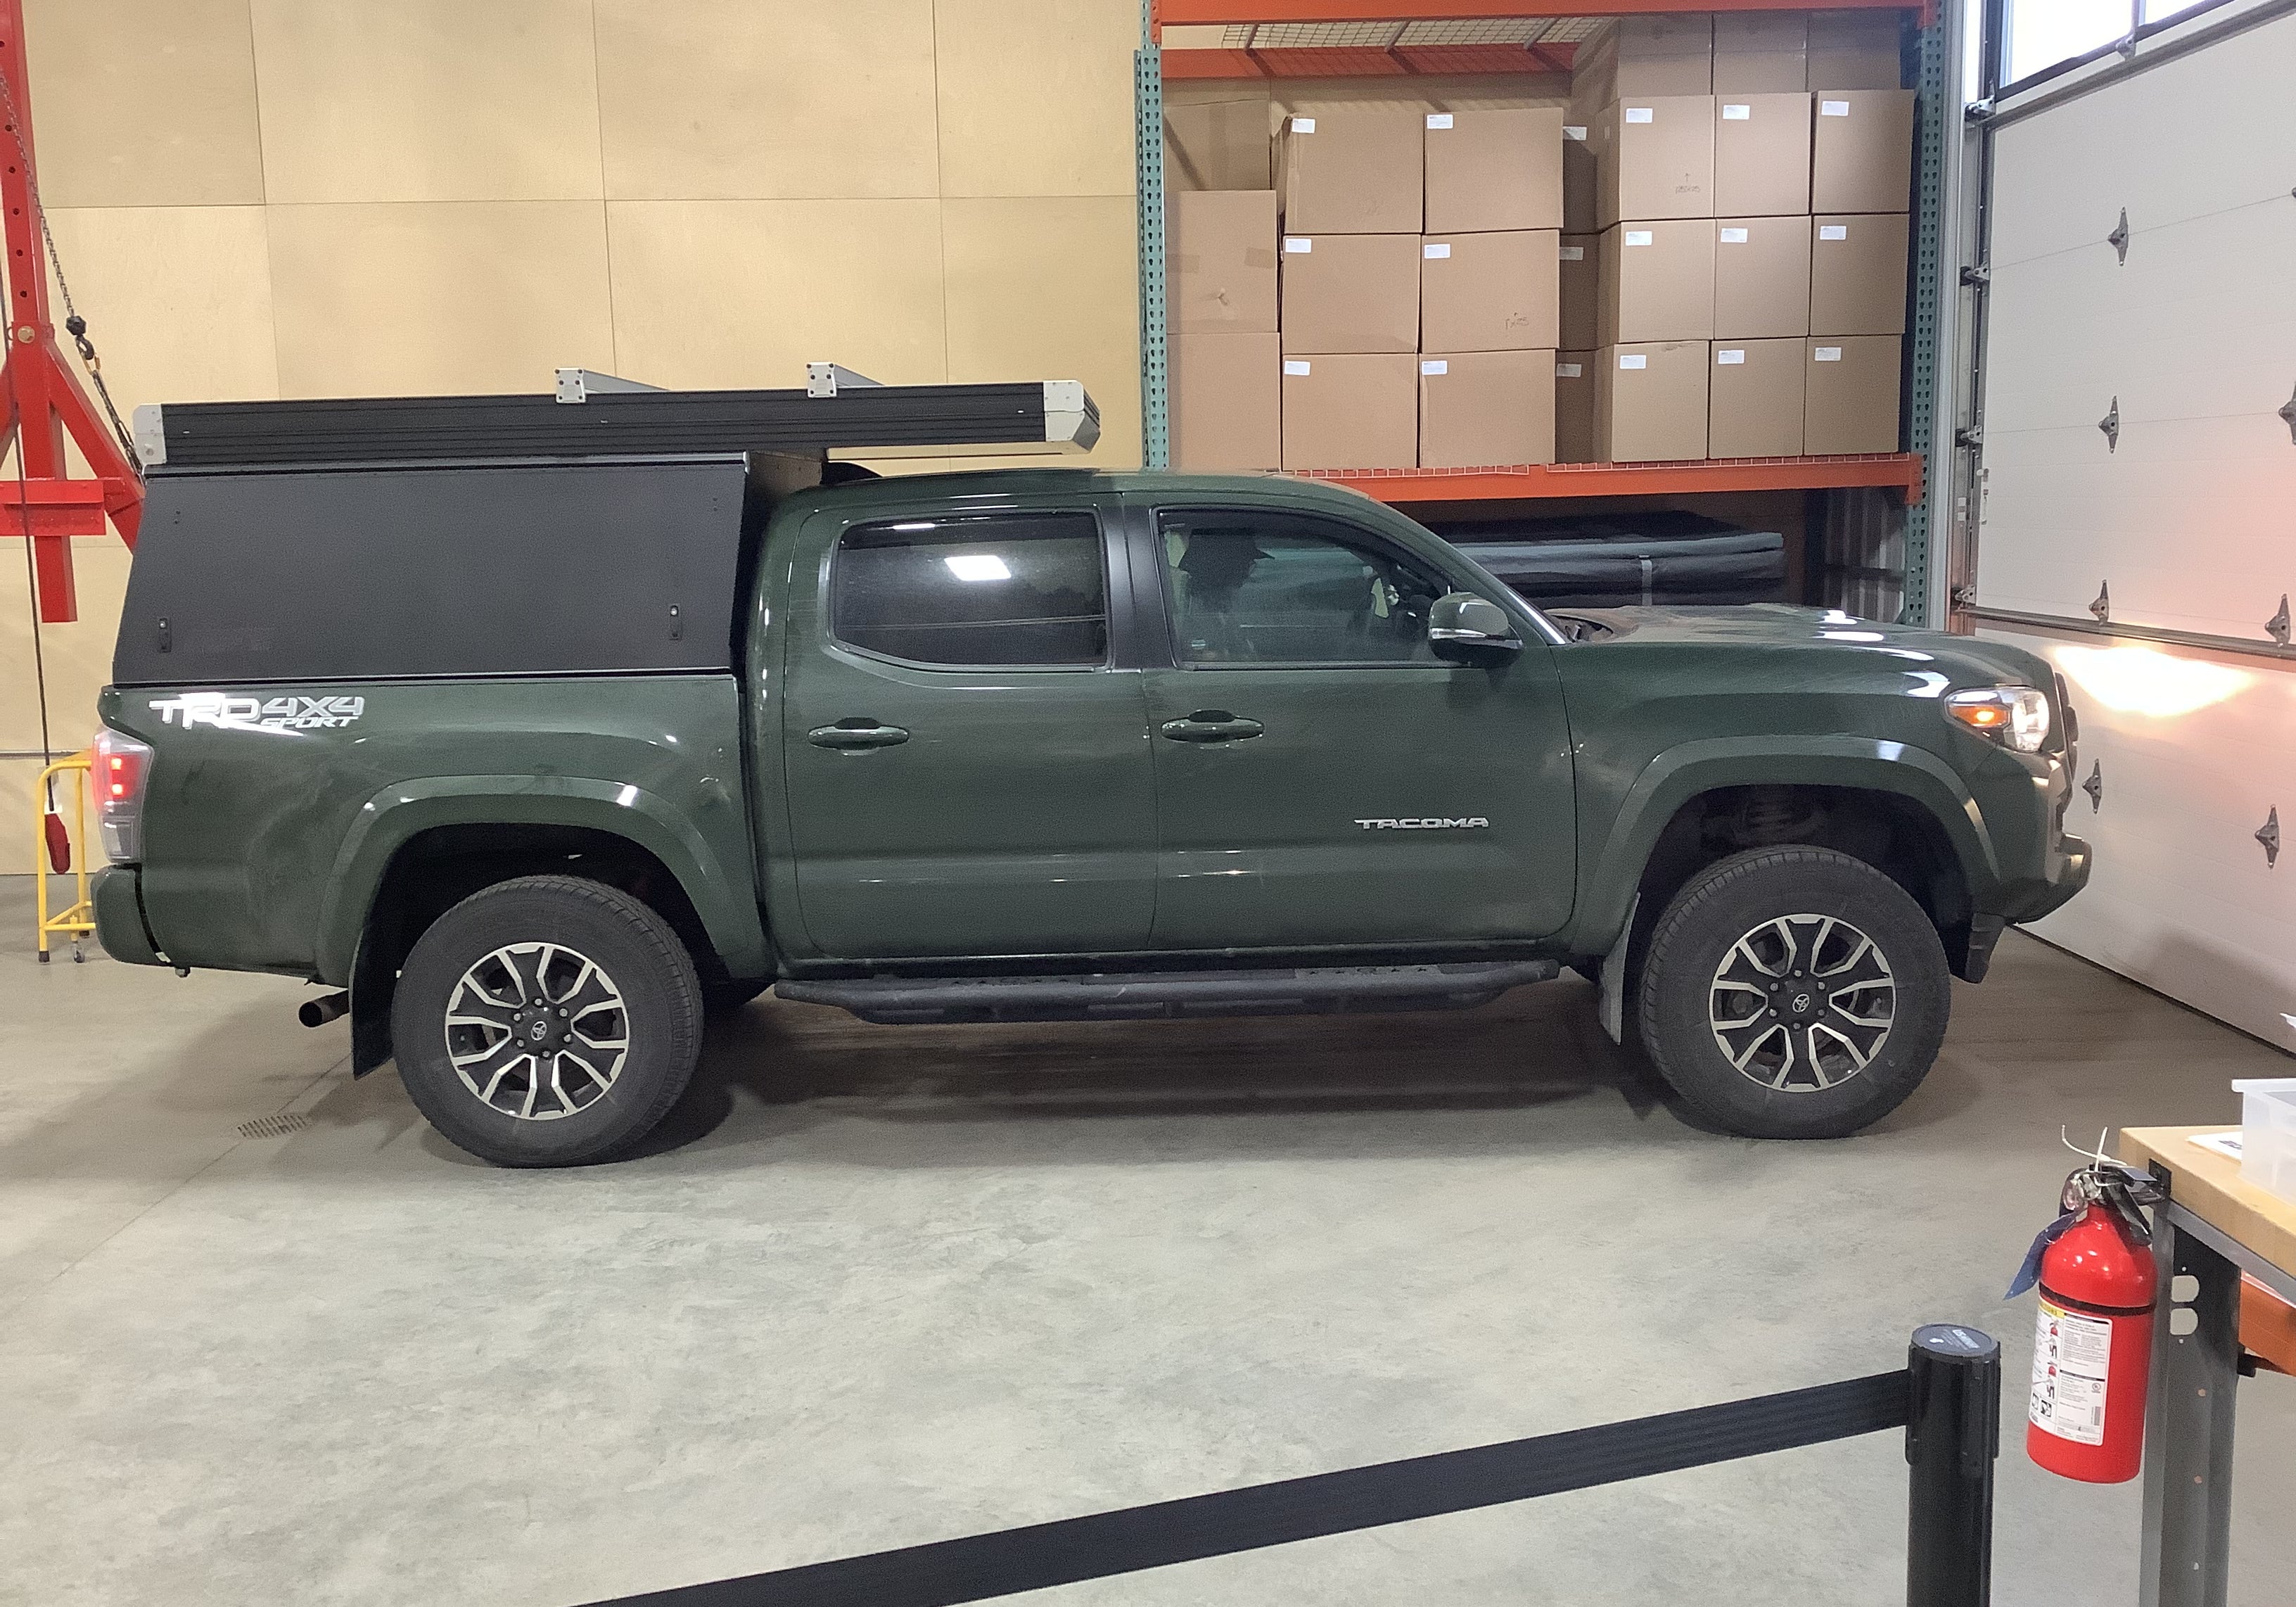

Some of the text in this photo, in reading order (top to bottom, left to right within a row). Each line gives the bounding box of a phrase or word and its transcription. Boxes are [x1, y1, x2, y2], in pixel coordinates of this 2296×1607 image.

[148, 692, 365, 729] TRD 4X4
[260, 716, 359, 729] SPORT
[1354, 818, 1489, 829] TACOMA
